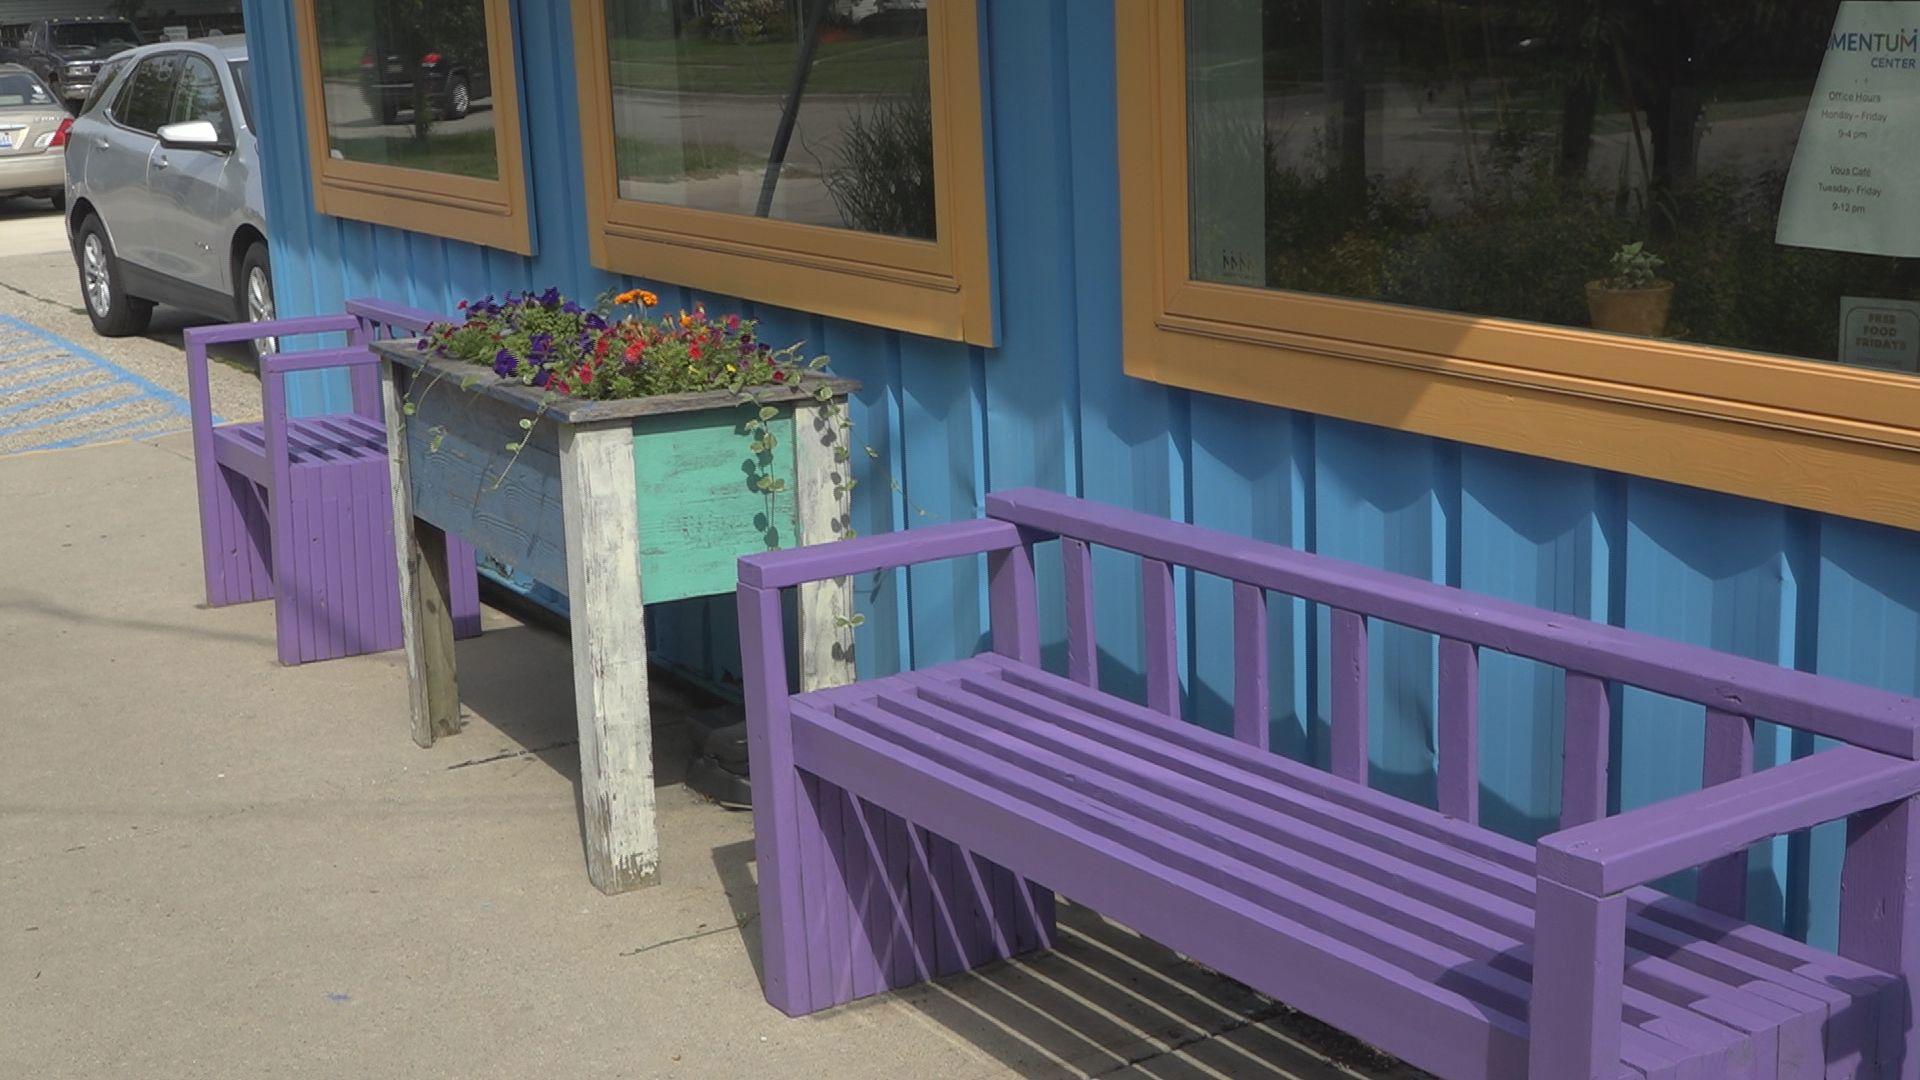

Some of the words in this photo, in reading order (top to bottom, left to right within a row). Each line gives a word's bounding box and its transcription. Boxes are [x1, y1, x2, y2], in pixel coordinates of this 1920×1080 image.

[1827, 29, 1918, 53] MENTUM
[1871, 57, 1916, 69] CENTER
[1829, 91, 1854, 101] Office
[1855, 92, 1881, 103] Hours
[1821, 109, 1853, 121] Monday
[1861, 111, 1888, 123] Friday
[1853, 131, 1867, 139] pm
[1856, 185, 1881, 198] Friday
[1832, 201, 1850, 212] 9-12
[1852, 205, 1865, 213] pm
[1863, 325, 1897, 337] FOOD
